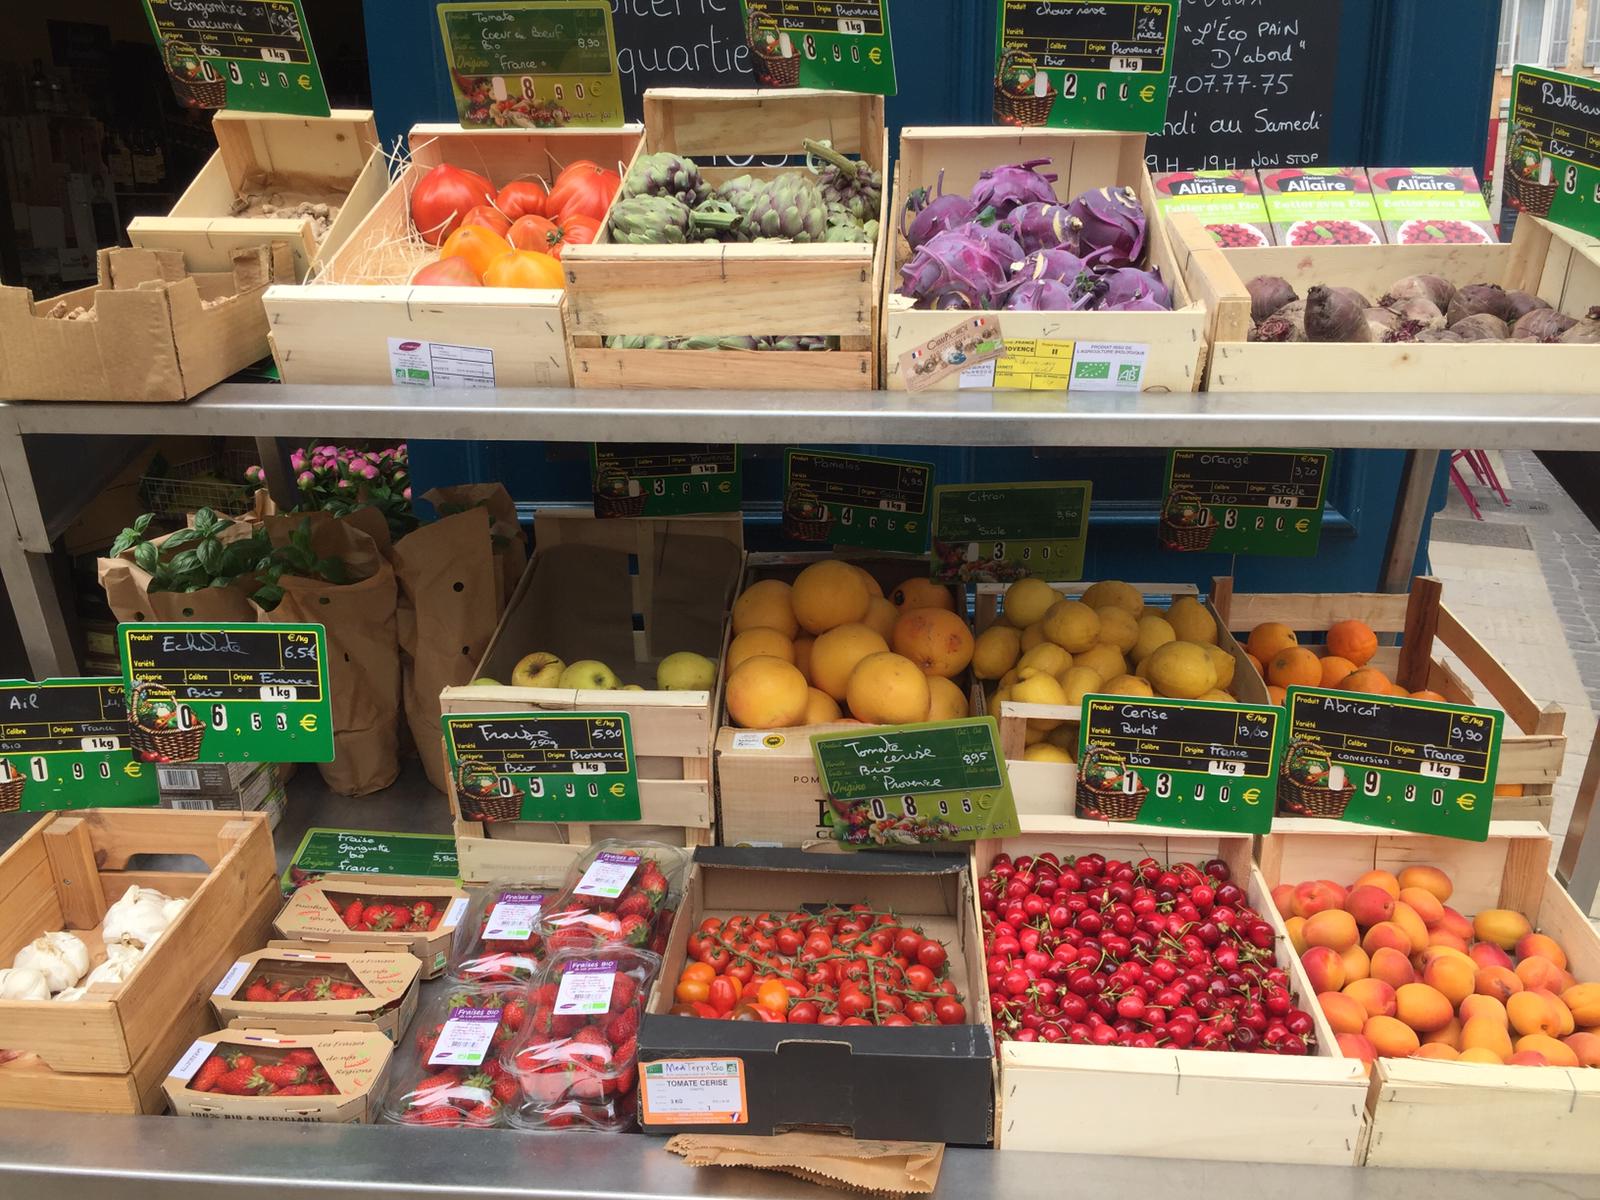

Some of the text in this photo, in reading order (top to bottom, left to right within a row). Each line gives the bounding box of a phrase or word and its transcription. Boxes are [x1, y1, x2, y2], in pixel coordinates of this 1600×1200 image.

[472, 12, 515, 23] Tomate
[482, 24, 564, 40] Coeur Boeuf
[201, 45, 221, 56] Bio
[481, 40, 501, 50] Bio
[500, 55, 538, 70] France
[617, 24, 753, 94] quartie
[1044, 55, 1065, 65] Bio
[1210, 120, 1241, 134] au
[1254, 108, 1322, 132] Samedi
[1251, 151, 1279, 166] NON
[1286, 154, 1319, 164] STOP
[1179, 183, 1237, 194] Allaire
[1287, 181, 1346, 191] Allaire
[1397, 180, 1456, 190] Allaire
[1201, 455, 1249, 468] Orange
[968, 491, 1006, 502] Citron
[130, 634, 153, 642] Produit
[133, 660, 154, 668] Variété
[135, 672, 317, 687] Catégorie Calibre Origine France
[187, 686, 223, 698] Bio
[9, 693, 39, 710] Ail
[1296, 696, 1380, 717] Produit Abricot
[1093, 703, 1168, 720] Produit Cerise
[81, 724, 116, 733] France
[1091, 727, 1111, 735] Variété
[1121, 722, 1158, 736] Burlat
[1295, 720, 1316, 729] Variété
[478, 724, 553, 741] Fraise
[1451, 727, 1483, 744] 9,90
[844, 735, 903, 758] Tomate
[1184, 746, 1205, 754] Origine
[1209, 743, 1248, 758] France
[1347, 739, 1467, 763] Calibre Origine France
[570, 749, 624, 761] Provence
[1129, 753, 1151, 764] bio
[1337, 752, 1389, 765] conversion
[504, 763, 537, 773] Bio
[859, 761, 895, 776] Bio
[793, 776, 820, 784] POM
[338, 832, 375, 844] Fraise
[338, 860, 380, 873] France
[572, 962, 599, 970] Fraises
[700, 1079, 728, 1087] CERISE
